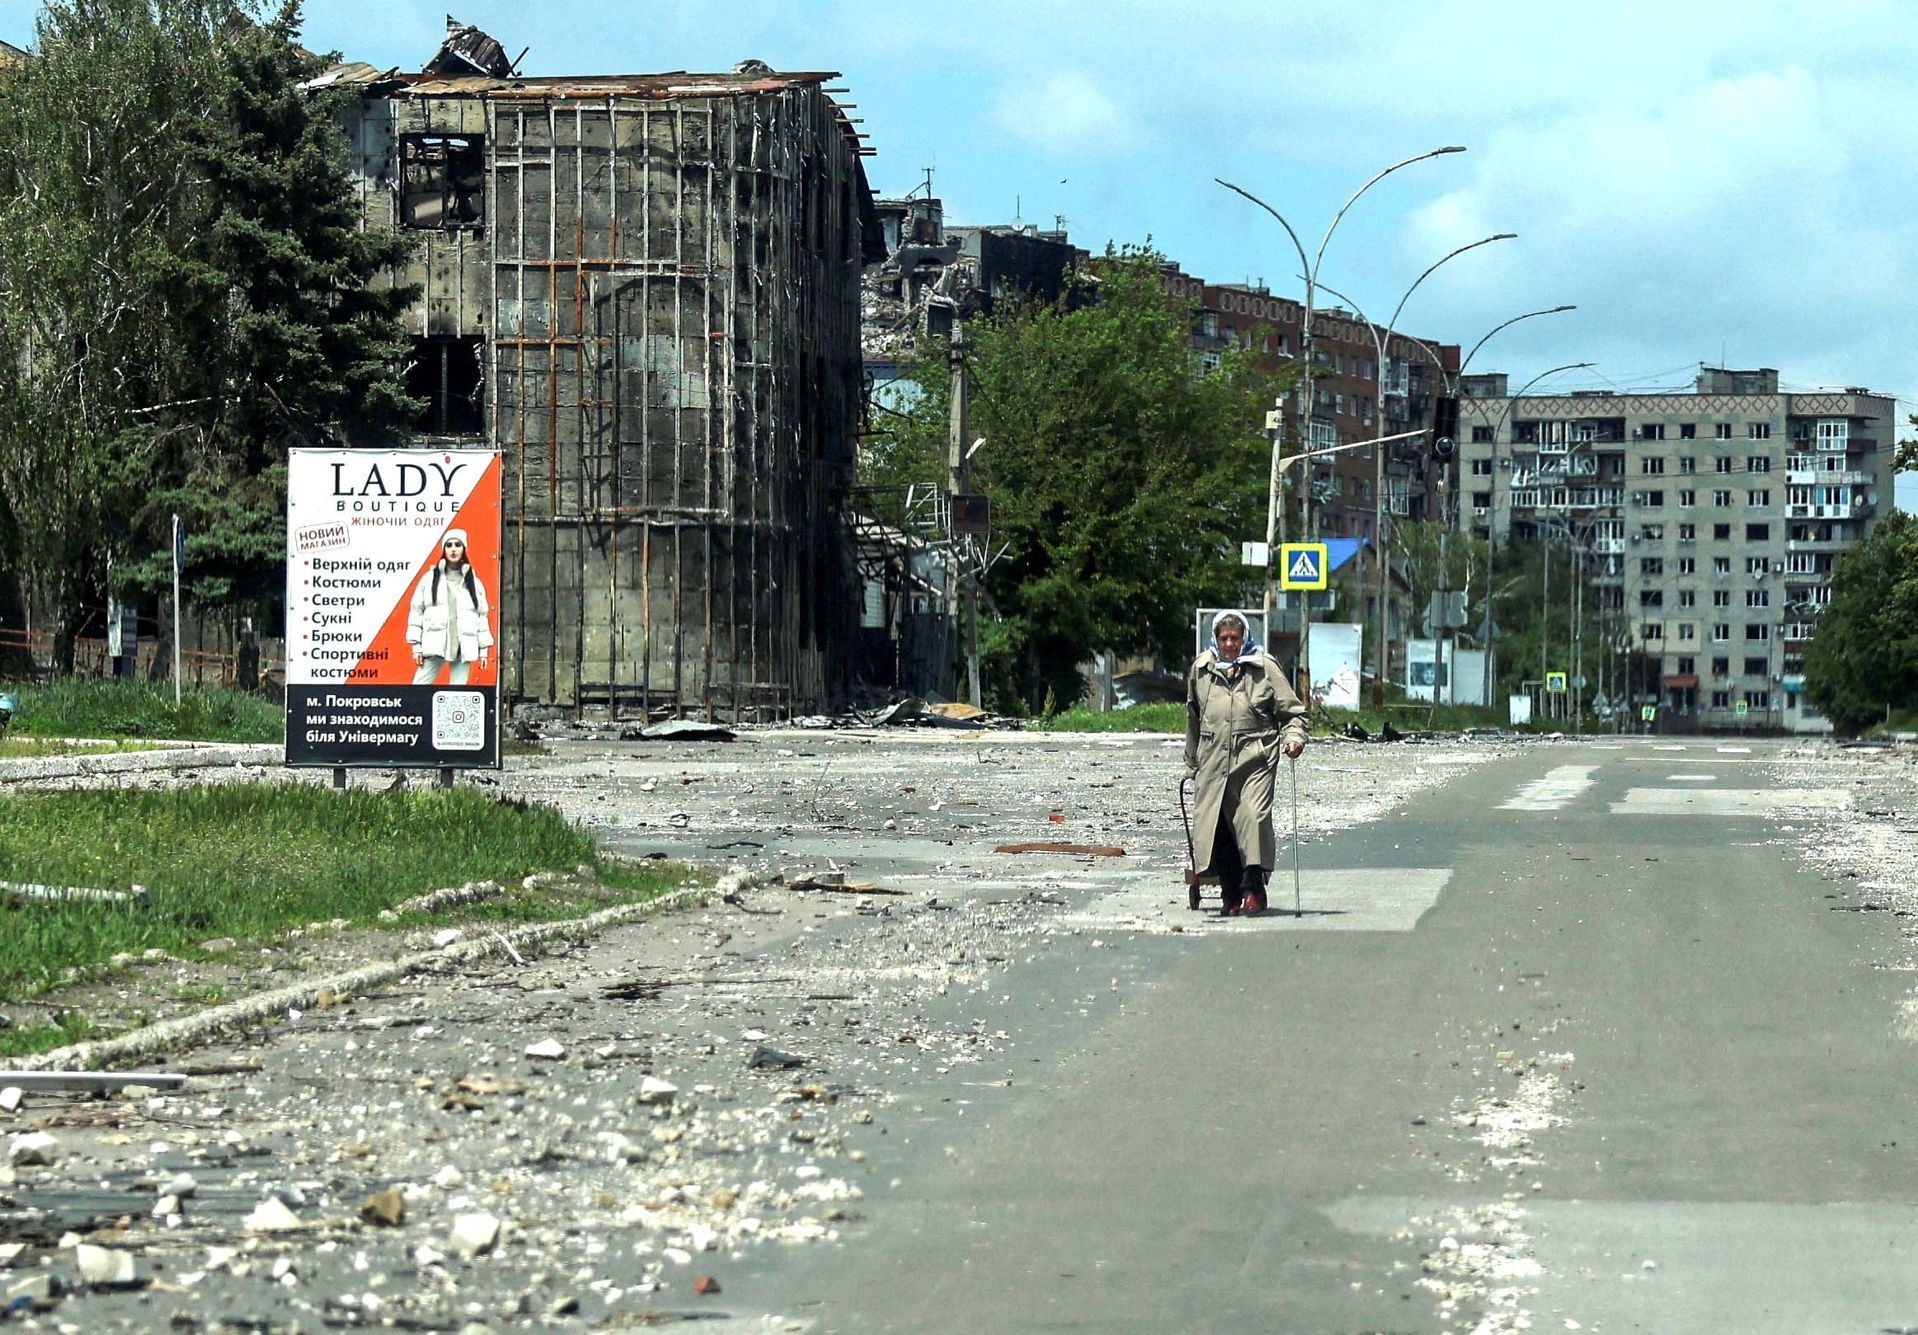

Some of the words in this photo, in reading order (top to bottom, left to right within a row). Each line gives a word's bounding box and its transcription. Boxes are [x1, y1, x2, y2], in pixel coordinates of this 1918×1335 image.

[331, 463, 467, 496] LADY
[337, 501, 460, 512] BOUTIQUE
[299, 524, 344, 541] НОВИЙ
[301, 537, 346, 550] МАГАЗИН
[312, 558, 372, 573] Верхній
[377, 560, 411, 572] одяг
[312, 576, 381, 589] Костюми
[312, 594, 365, 609] Светри
[311, 612, 352, 627] Сукні
[311, 630, 362, 645] Брюки
[311, 648, 389, 663] Спортивні
[311, 667, 379, 678] костюми
[306, 697, 322, 708] м.
[325, 695, 402, 710] Покровськ
[306, 715, 326, 725] ми
[330, 715, 423, 728] знаходимося
[306, 730, 335, 743] біля
[339, 730, 419, 747] Універмагу
